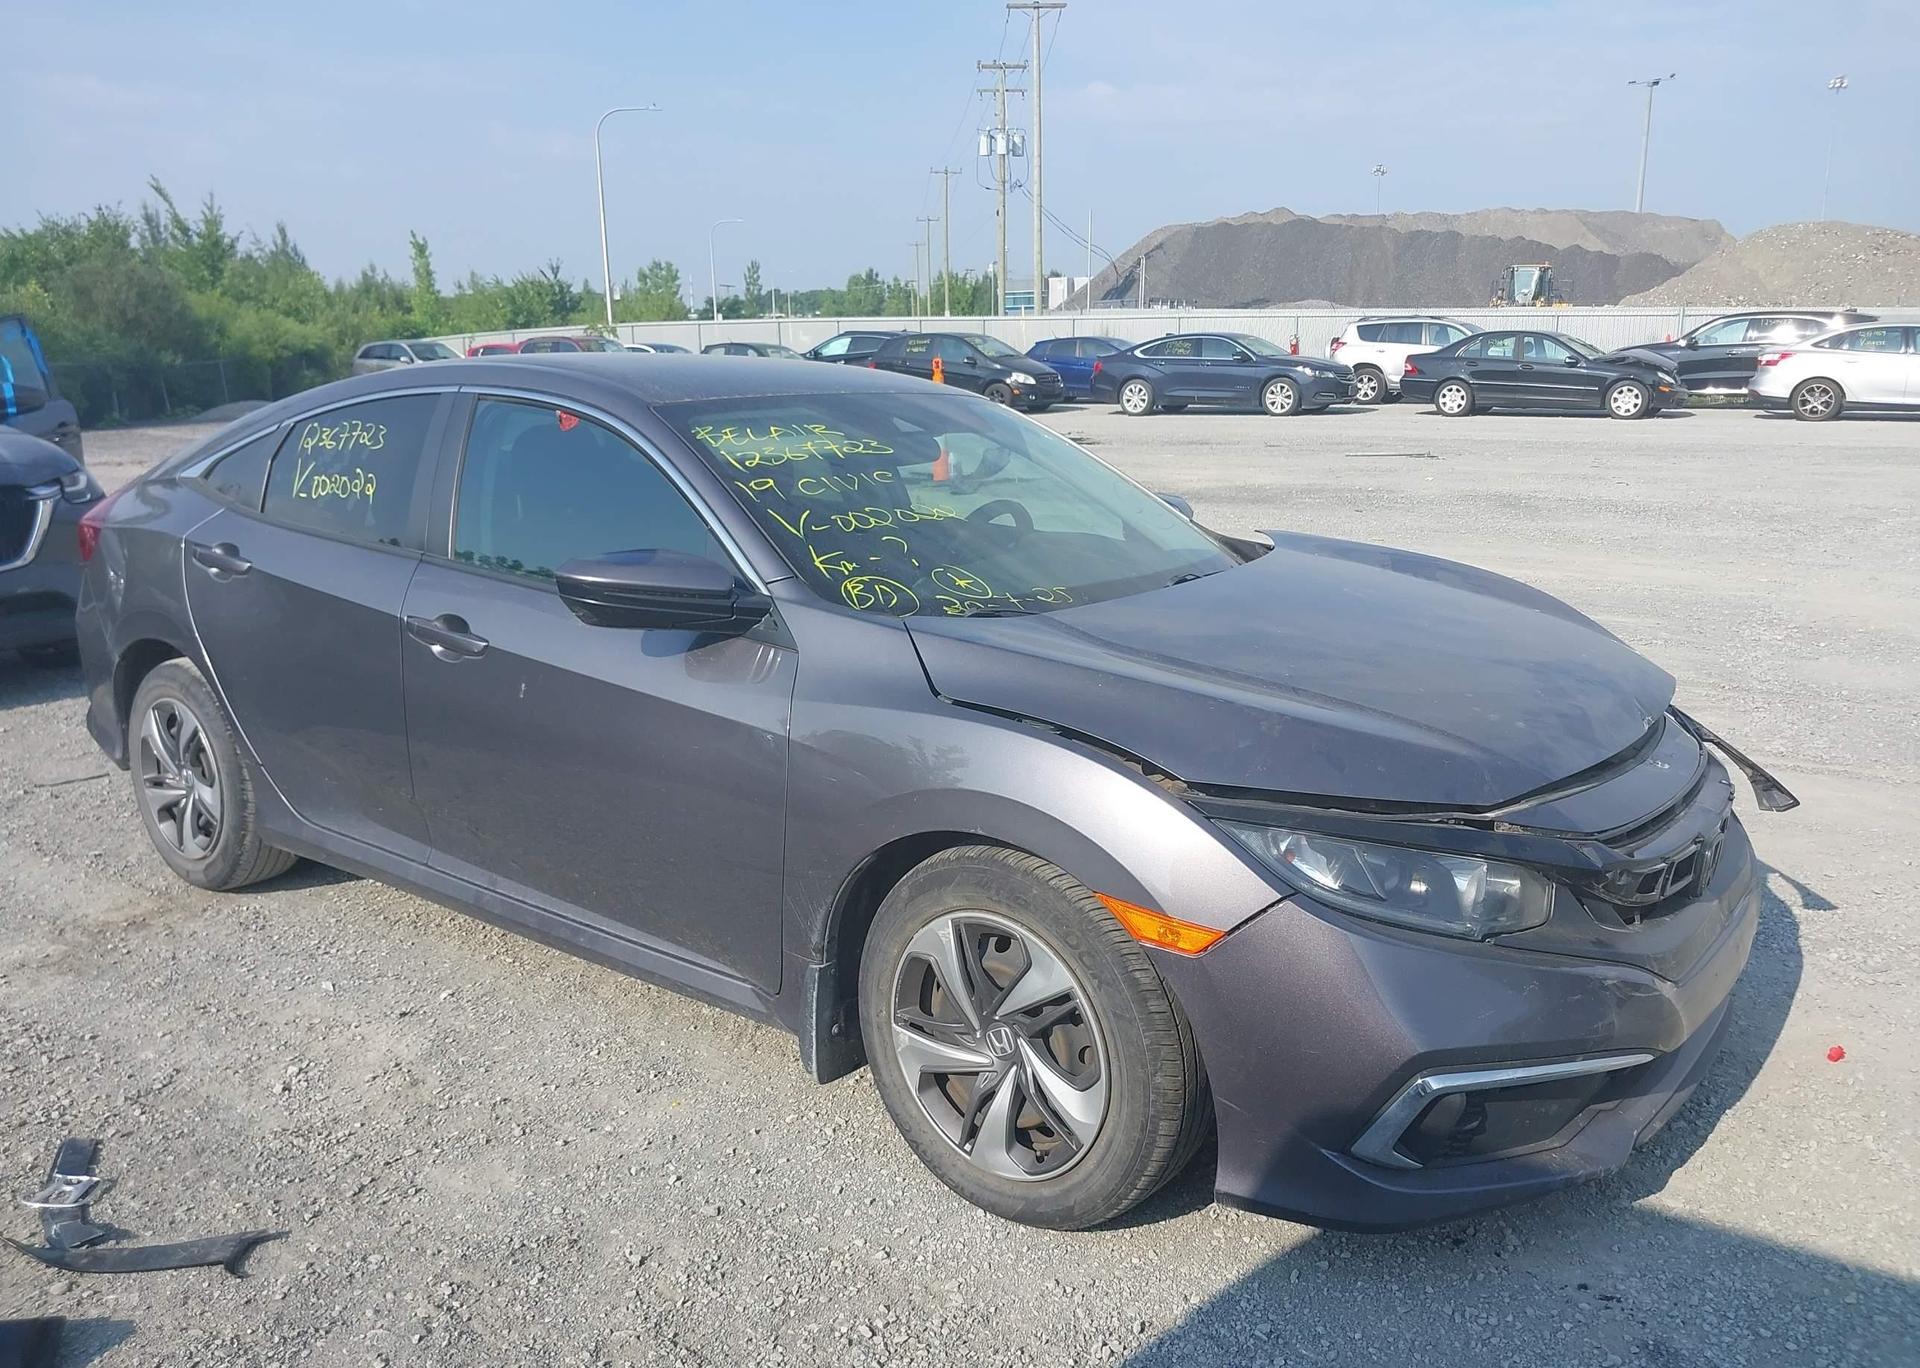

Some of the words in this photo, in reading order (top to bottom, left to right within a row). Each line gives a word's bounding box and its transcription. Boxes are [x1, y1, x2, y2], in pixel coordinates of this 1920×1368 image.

[691, 424, 845, 447] BELAIR
[735, 478, 787, 503] 19
[798, 471, 895, 495] CIVIC
